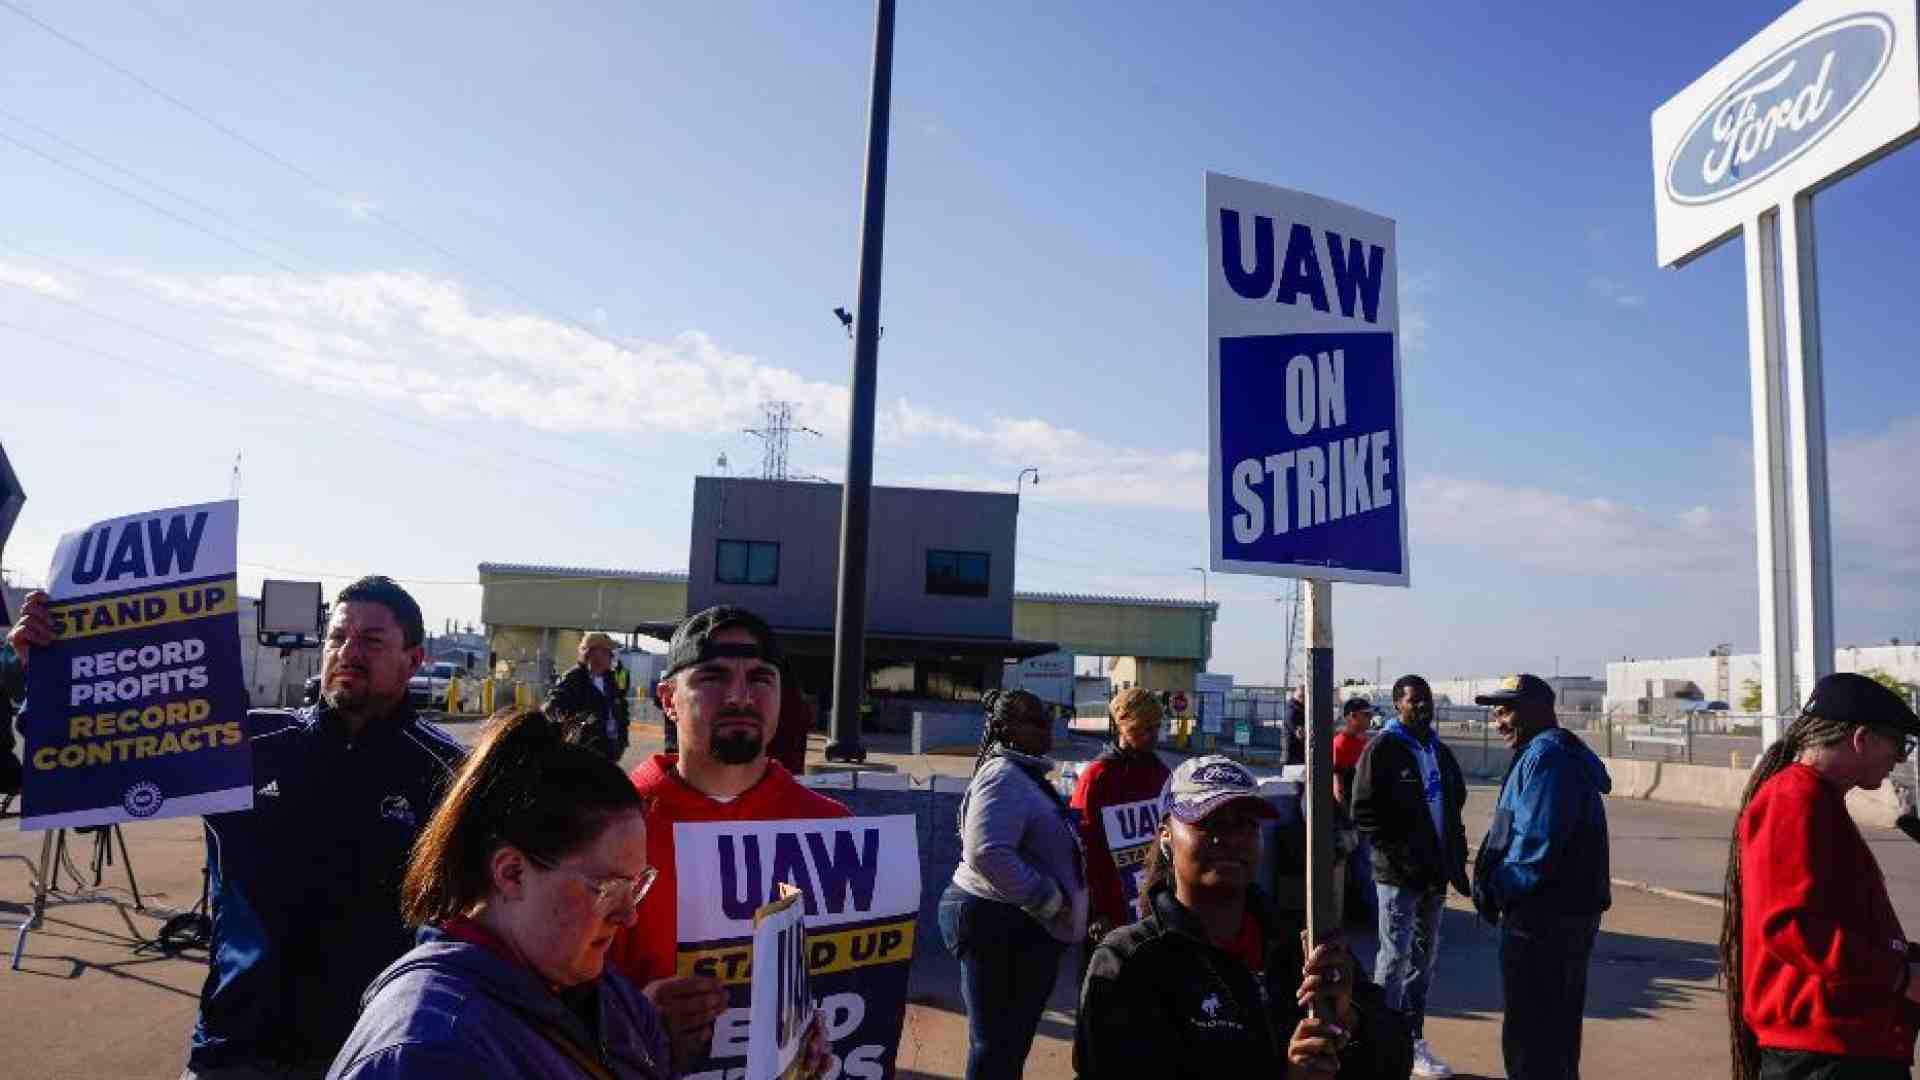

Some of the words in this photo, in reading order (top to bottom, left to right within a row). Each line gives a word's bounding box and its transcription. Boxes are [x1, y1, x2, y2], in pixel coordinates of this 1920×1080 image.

[1703, 50, 1836, 184] Ford
[1219, 207, 1386, 324] UAW
[1285, 349, 1347, 435] ON
[1231, 430, 1392, 544] STRIKE
[71, 511, 208, 585] UAW
[51, 595, 167, 636] STAND
[178, 587, 225, 615] UP
[71, 639, 205, 680] RECORD
[71, 666, 209, 706] PROFITS
[33, 721, 242, 770] CONTRACTS
[69, 699, 209, 740] RECORD
[717, 829, 880, 920] UAW
[851, 929, 902, 962] UP
